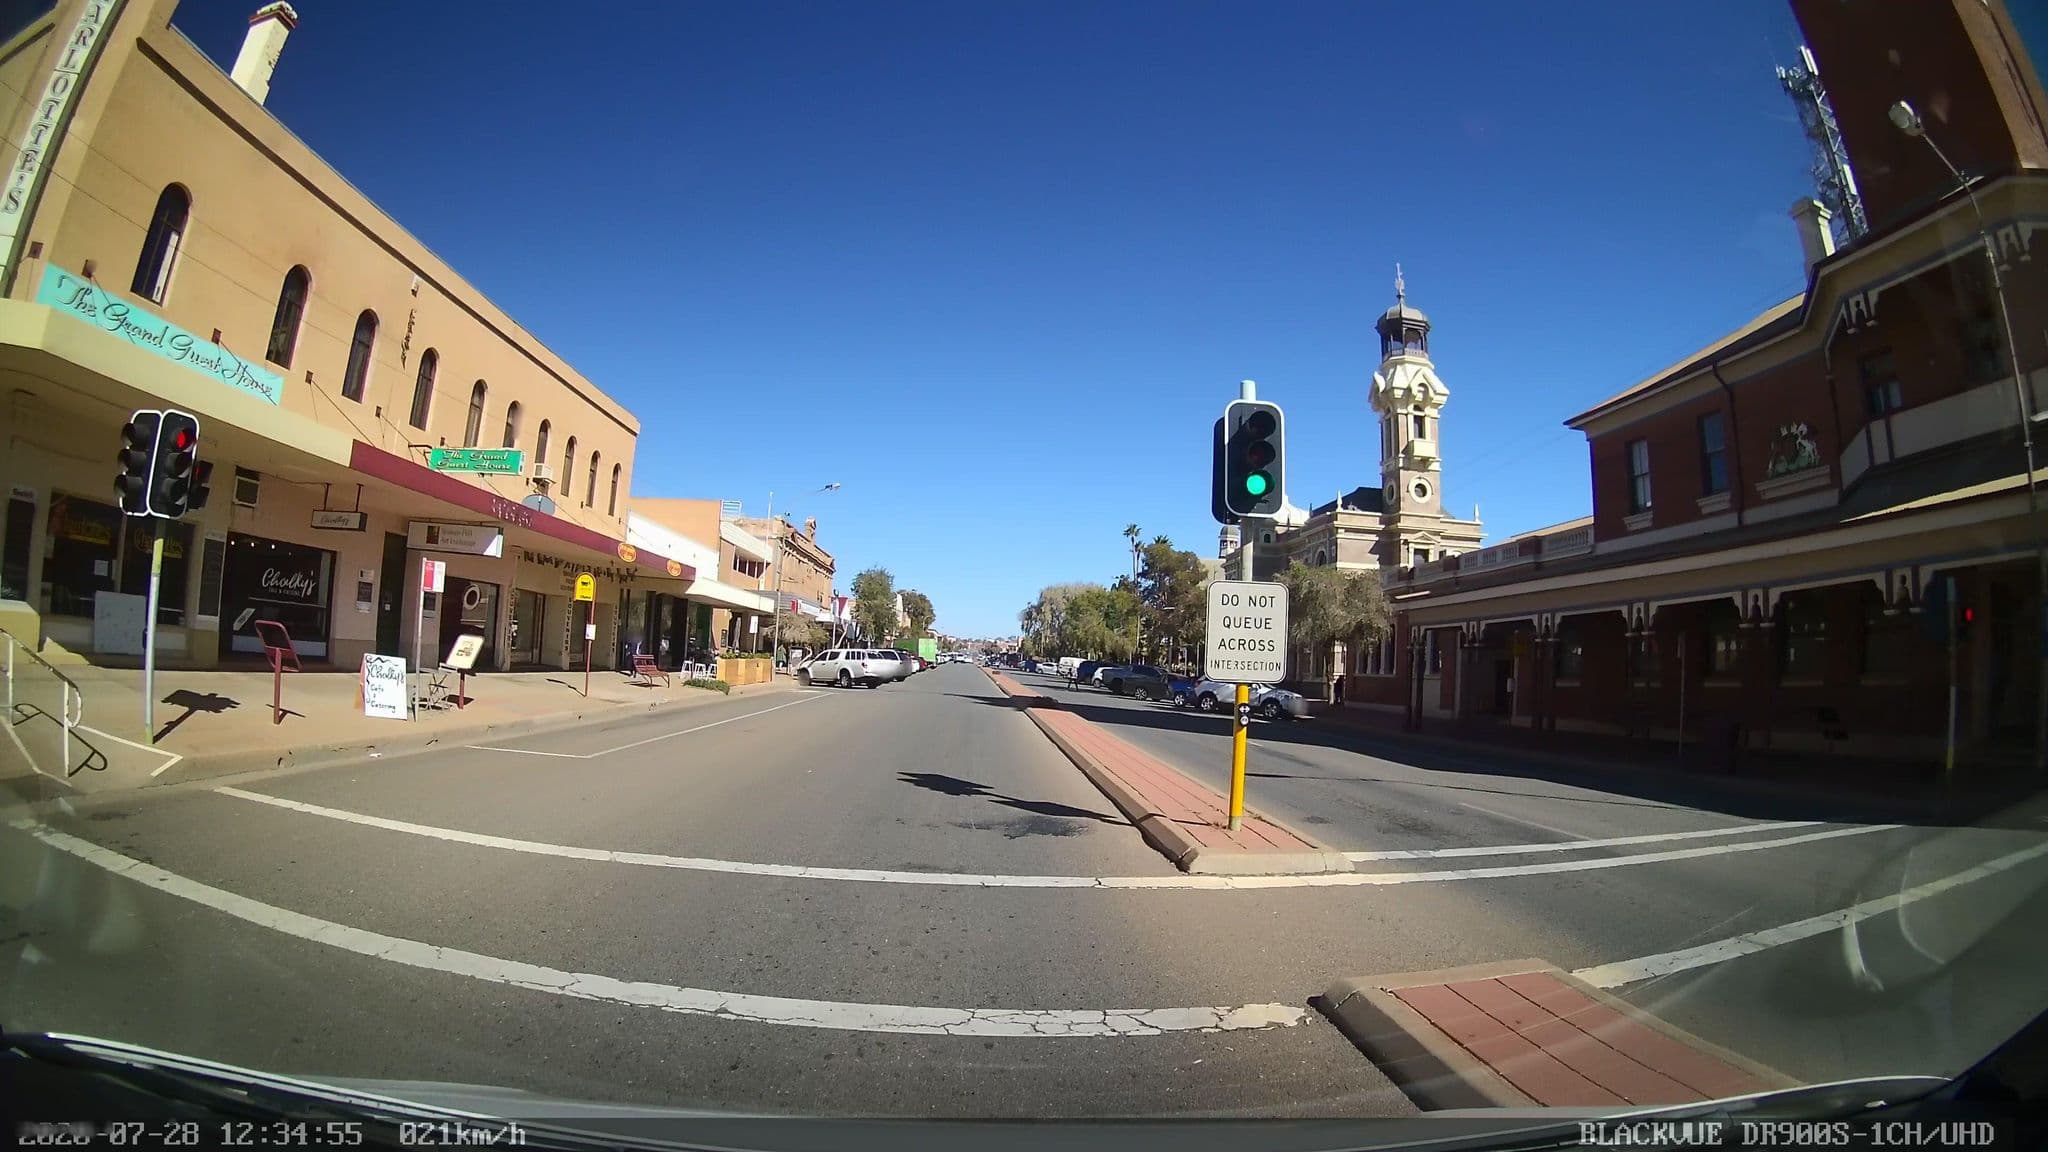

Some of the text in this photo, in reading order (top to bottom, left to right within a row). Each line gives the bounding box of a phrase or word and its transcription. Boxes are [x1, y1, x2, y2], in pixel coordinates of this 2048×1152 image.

[4, 0, 110, 214] ARLOTTE'S
[56, 274, 273, 397] The Grand Guest House
[475, 460, 511, 470] House
[262, 568, 316, 598] Chalky's
[1221, 593, 1276, 608] DO NOT
[1222, 615, 1273, 630] QUEUE
[1217, 638, 1275, 652] ACROSS
[1210, 659, 1281, 672] INTERSECTION
